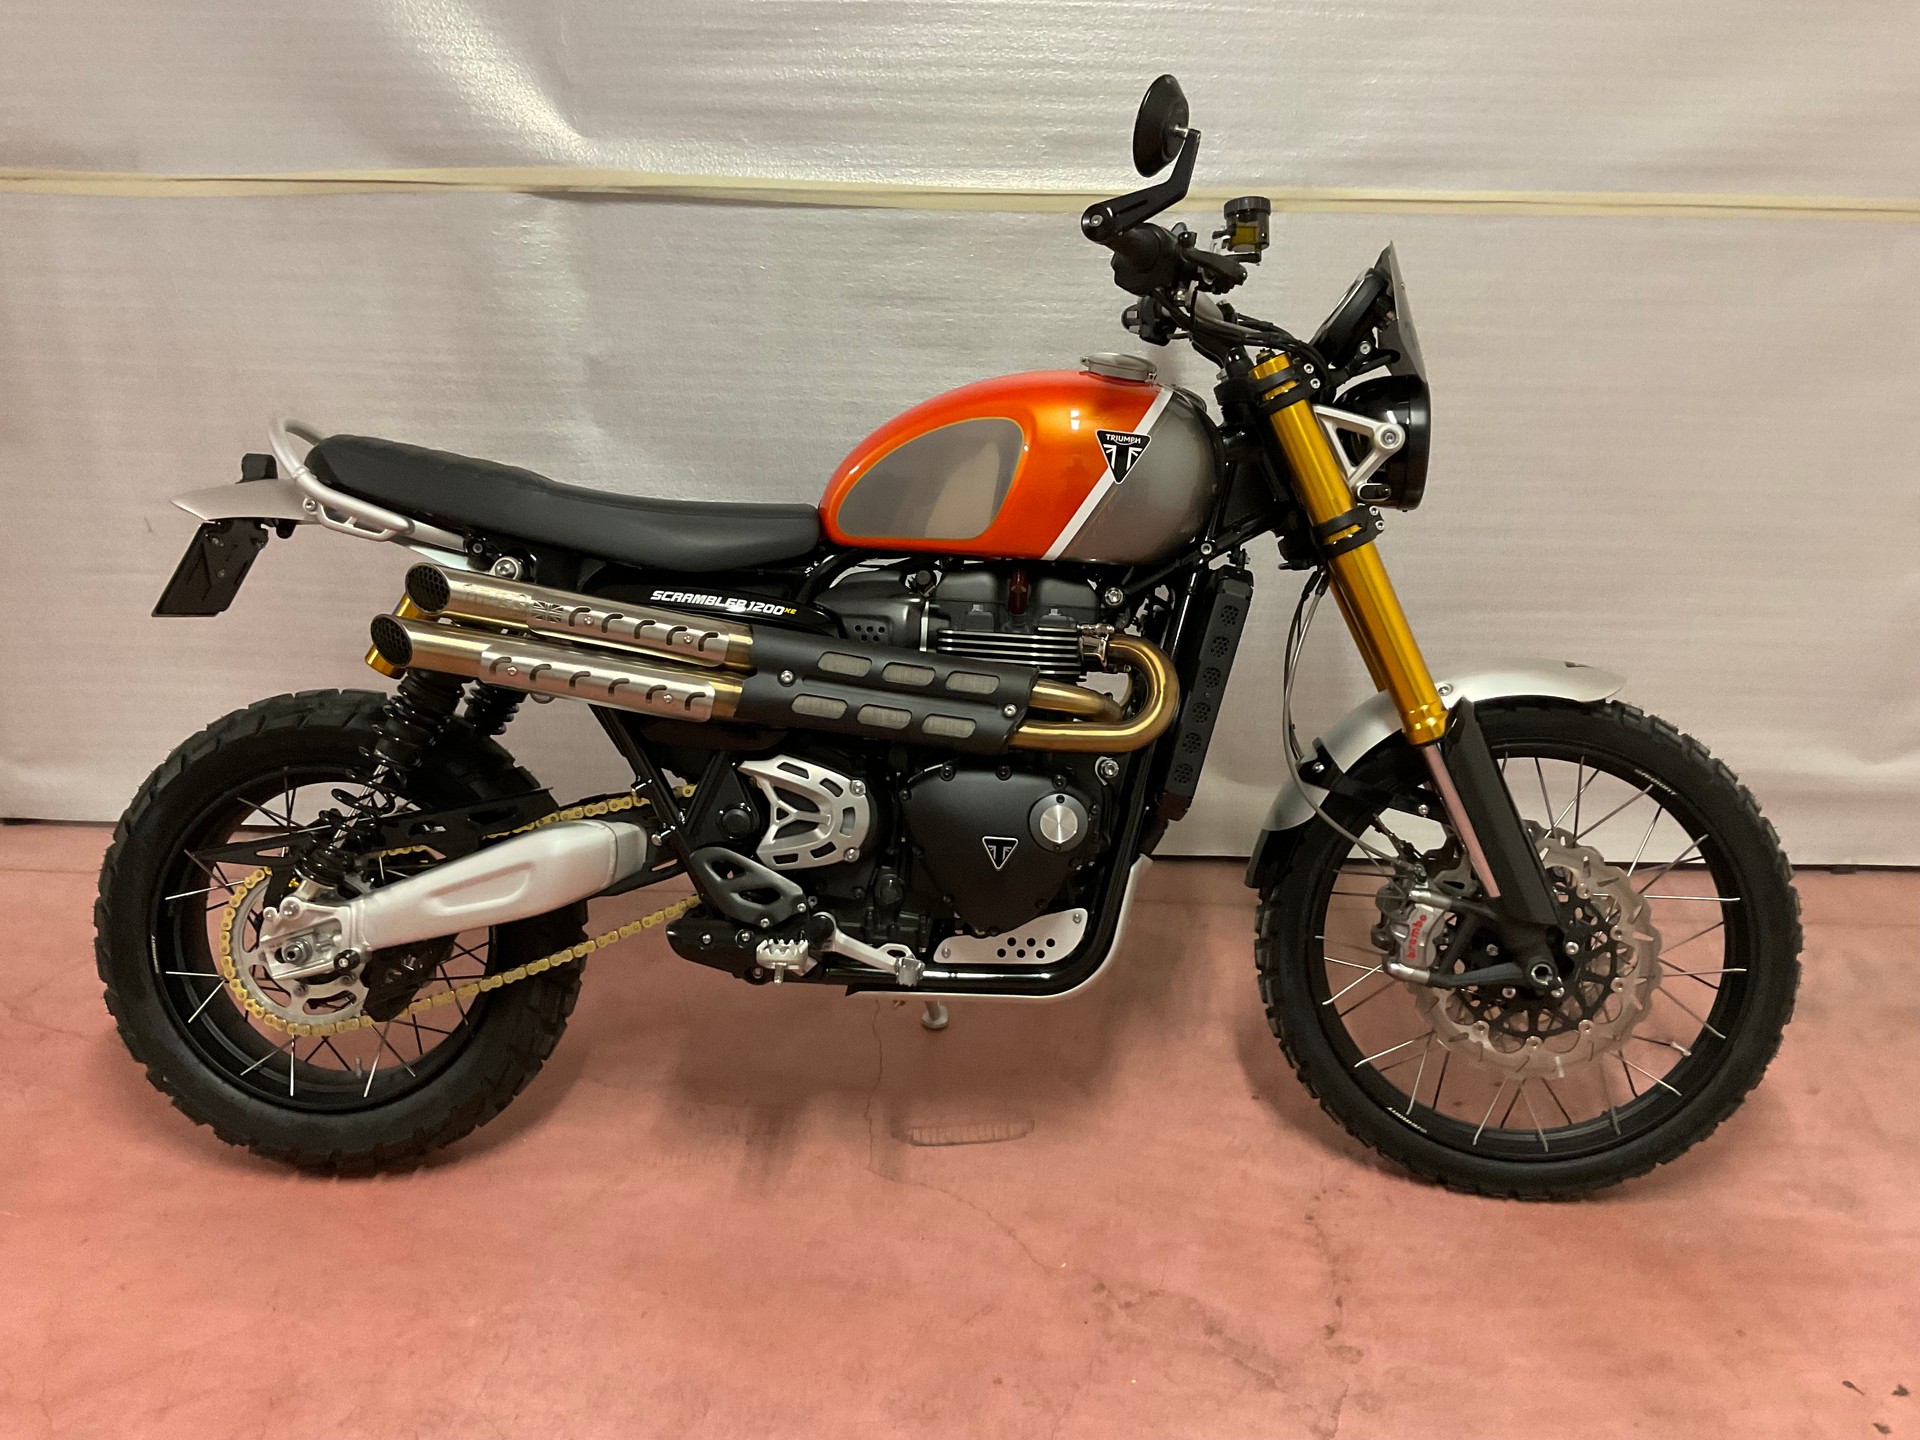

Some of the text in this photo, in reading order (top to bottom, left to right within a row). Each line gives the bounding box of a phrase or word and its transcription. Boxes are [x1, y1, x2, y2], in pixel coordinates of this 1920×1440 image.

[1105, 433, 1141, 445] TRIUMPH
[650, 590, 748, 610] SCRAMBLER
[746, 601, 786, 616] 1200
[1407, 914, 1428, 960] brembo
